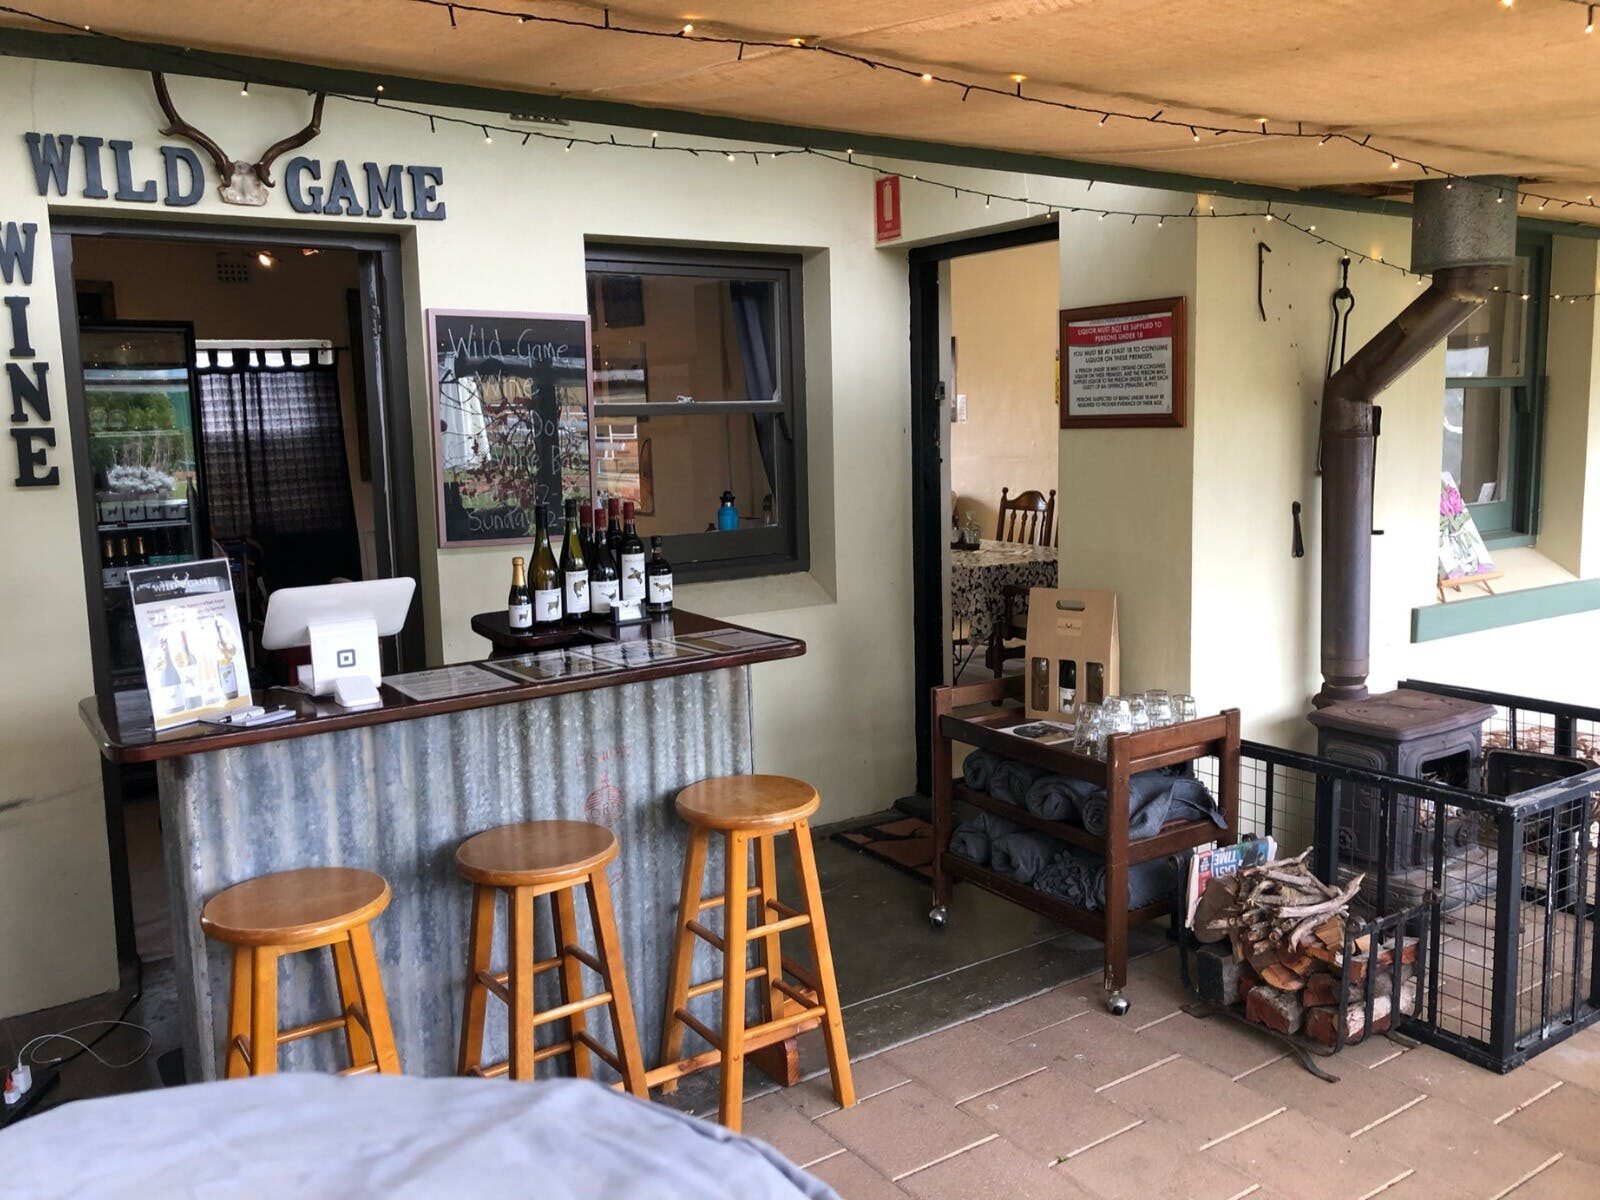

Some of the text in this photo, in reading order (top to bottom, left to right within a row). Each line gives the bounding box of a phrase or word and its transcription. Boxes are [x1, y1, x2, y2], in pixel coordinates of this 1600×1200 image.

[25, 131, 447, 220] WILD GAME
[1130, 322, 1153, 330] SUPPLIED
[448, 324, 569, 368] Wild Game
[1095, 334, 1117, 342] PERSONS
[0, 221, 60, 487] WINE
[1141, 344, 1168, 352] CONSUME
[1214, 850, 1237, 866] TIME
